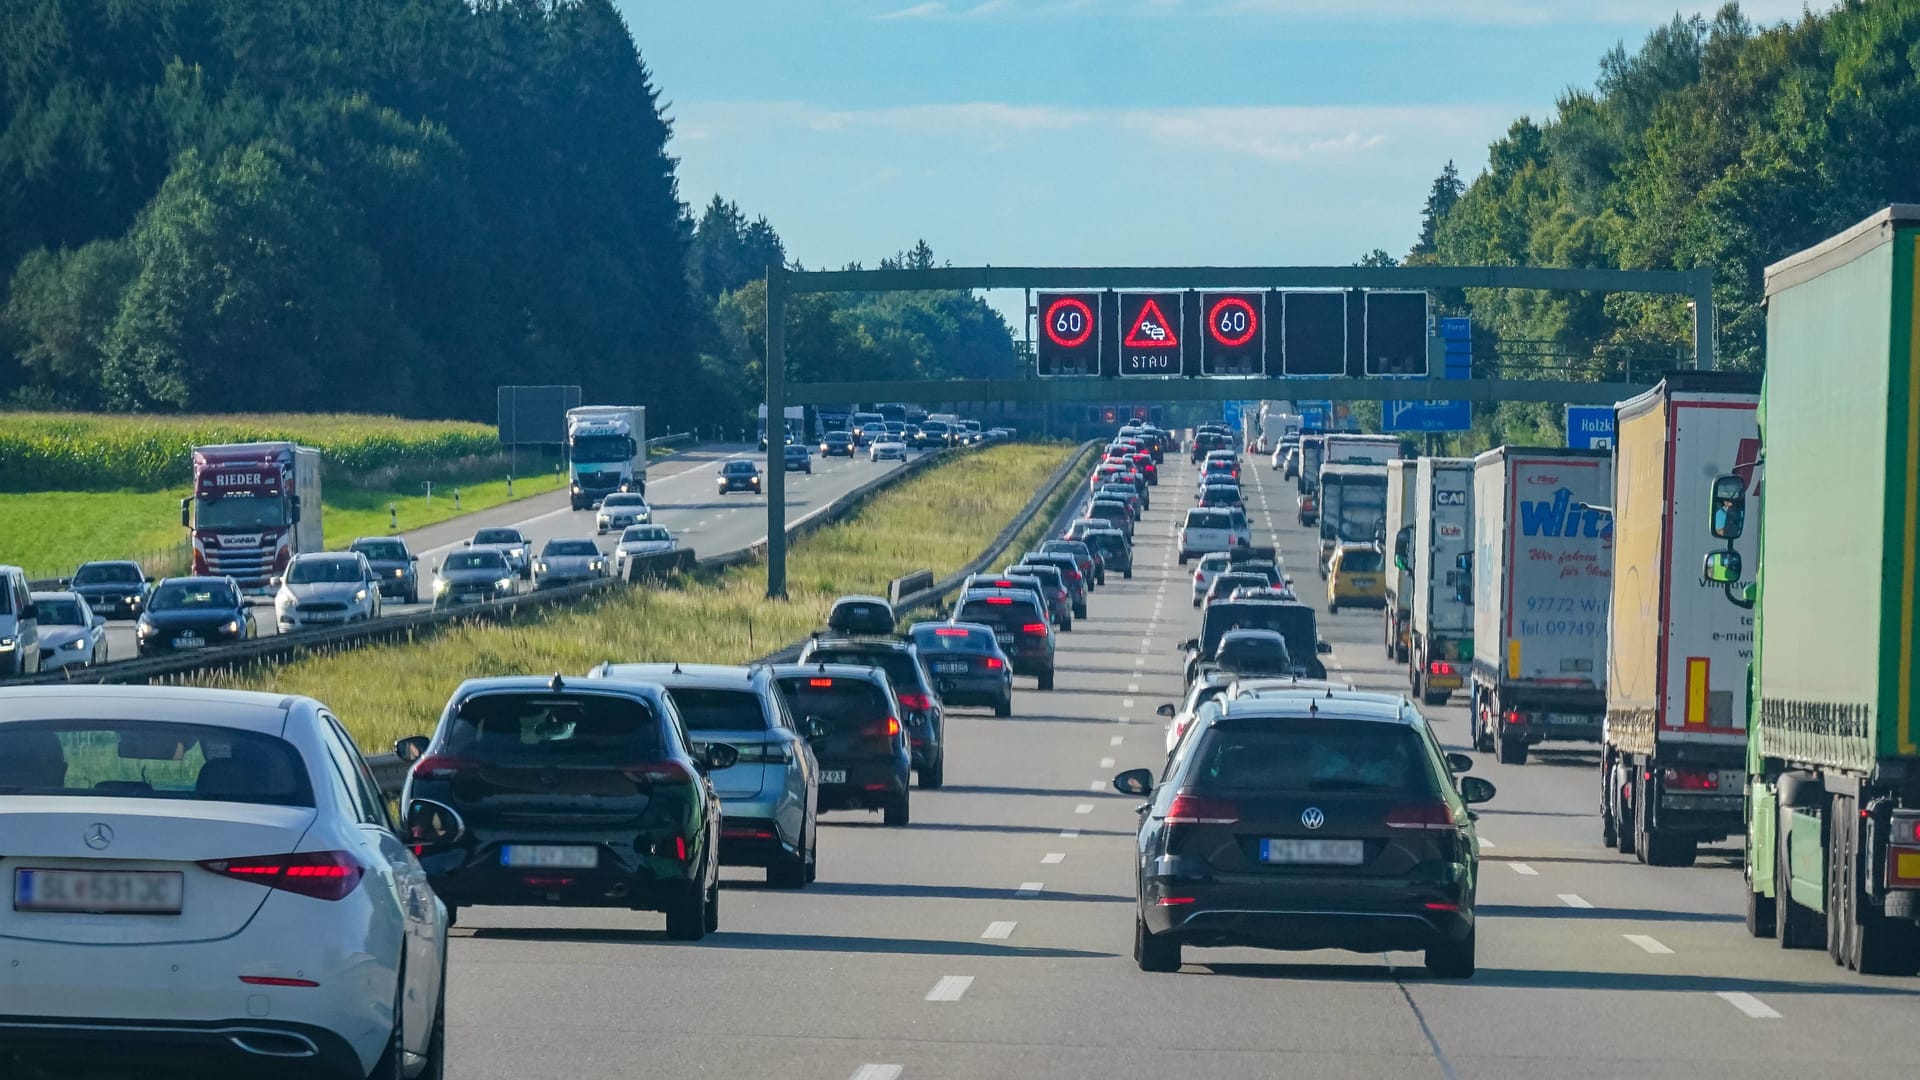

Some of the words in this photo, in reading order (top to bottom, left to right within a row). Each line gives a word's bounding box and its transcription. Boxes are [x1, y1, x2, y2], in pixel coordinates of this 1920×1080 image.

[1057, 312, 1081, 332] 60
[1221, 312, 1245, 332] 60
[1132, 356, 1168, 368] STAU
[216, 473, 261, 486] RIEDER
[1438, 492, 1465, 505] CAI
[223, 537, 256, 545] SCANIA
[1527, 596, 1574, 612] 97772
